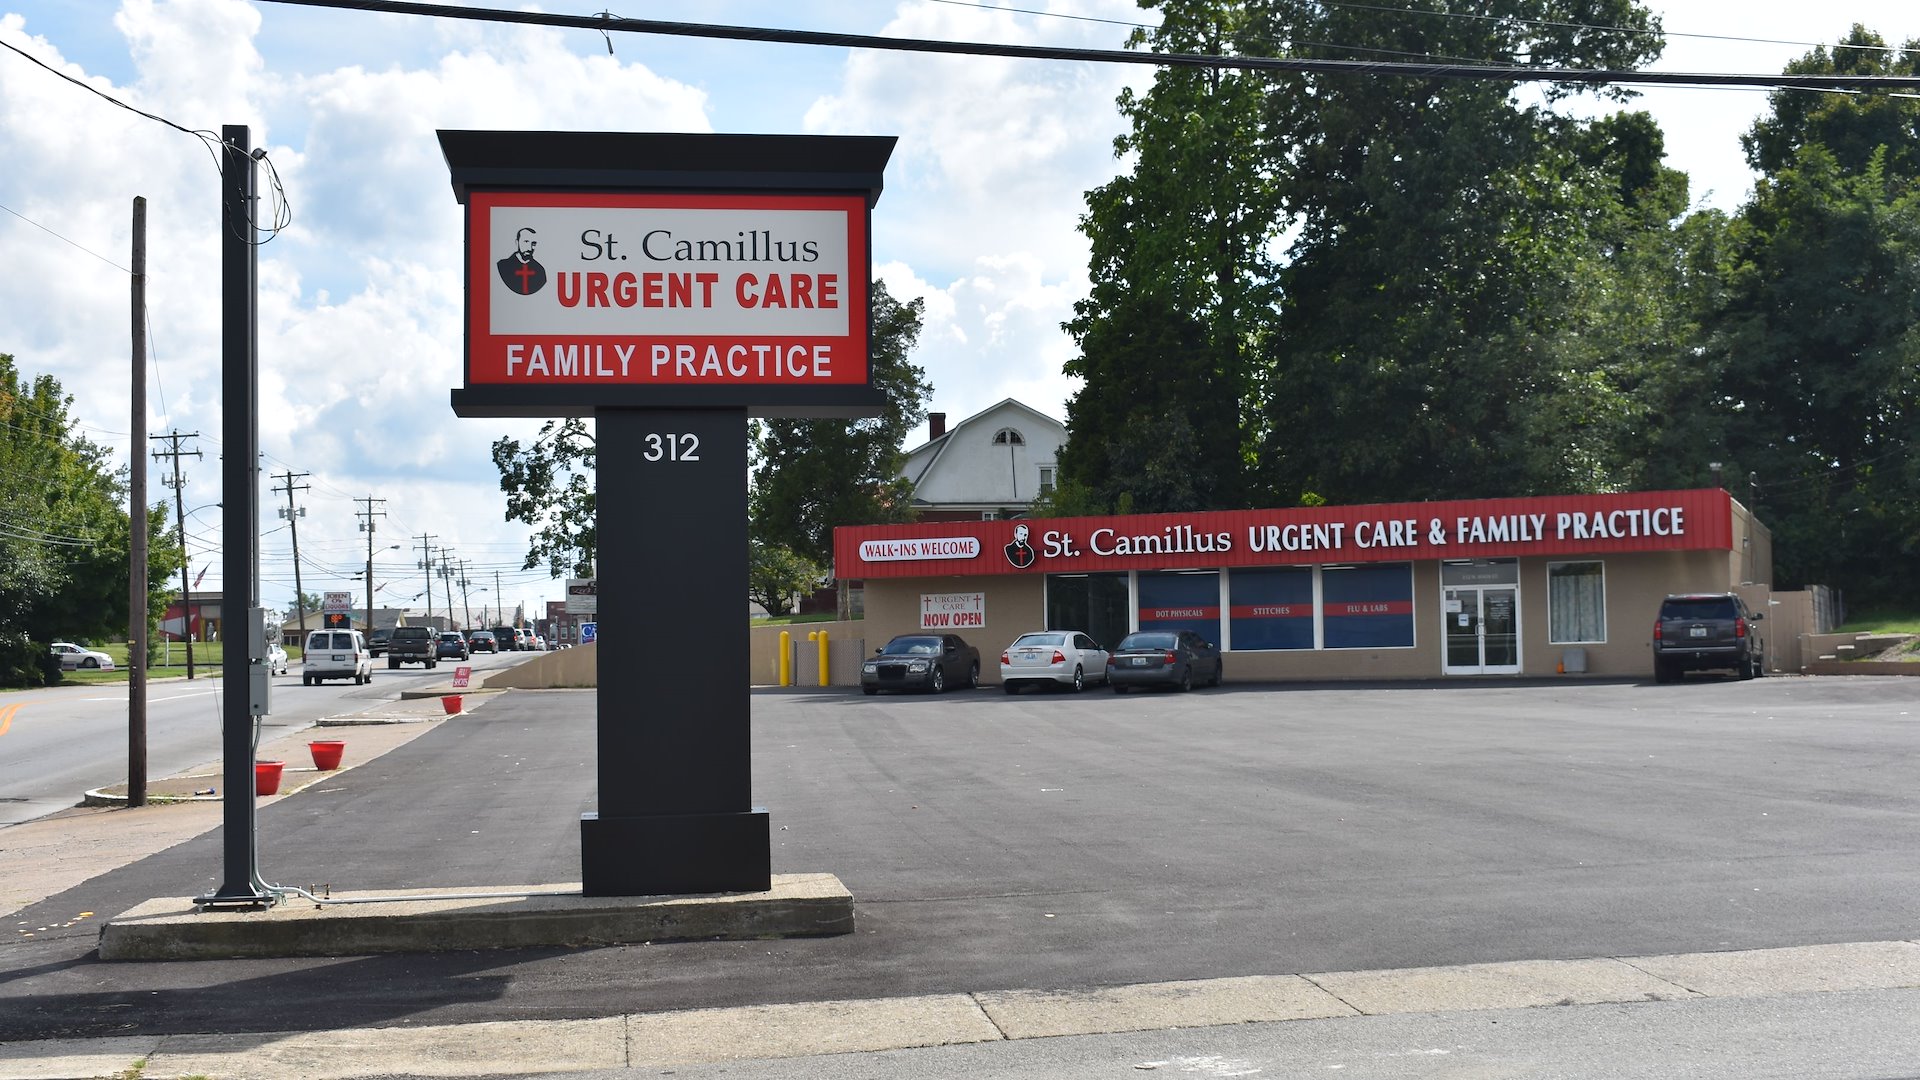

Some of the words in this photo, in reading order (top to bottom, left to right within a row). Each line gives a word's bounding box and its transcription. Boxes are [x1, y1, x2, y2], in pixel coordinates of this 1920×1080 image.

[580, 229, 628, 262] St.
[642, 230, 819, 263] Camillus
[557, 272, 719, 308] URGENT
[735, 273, 839, 309] CARE
[506, 344, 636, 377] FAMILY
[651, 345, 832, 377] PRACTICE
[643, 433, 700, 462] 312
[1043, 530, 1081, 558] St.
[1089, 524, 1232, 556] Camillus
[1248, 522, 1345, 552] URGENT
[1354, 519, 1418, 548] CARE
[1428, 517, 1447, 545] &
[1457, 513, 1546, 544] FAMILY
[1557, 507, 1684, 540] PRACTICE
[865, 543, 917, 557] WALK-INS
[921, 541, 974, 556] WELCOME
[934, 595, 970, 603] URGENT
[942, 603, 966, 611] CARE
[1155, 610, 1169, 618] DOT
[1170, 609, 1203, 617] PHYSICALS
[1253, 607, 1290, 615] STITCHES
[1347, 605, 1360, 613] FLU
[1362, 604, 1368, 612] &
[1370, 604, 1388, 612] LABS
[923, 613, 950, 627] NOW
[953, 612, 982, 626] OPEN
